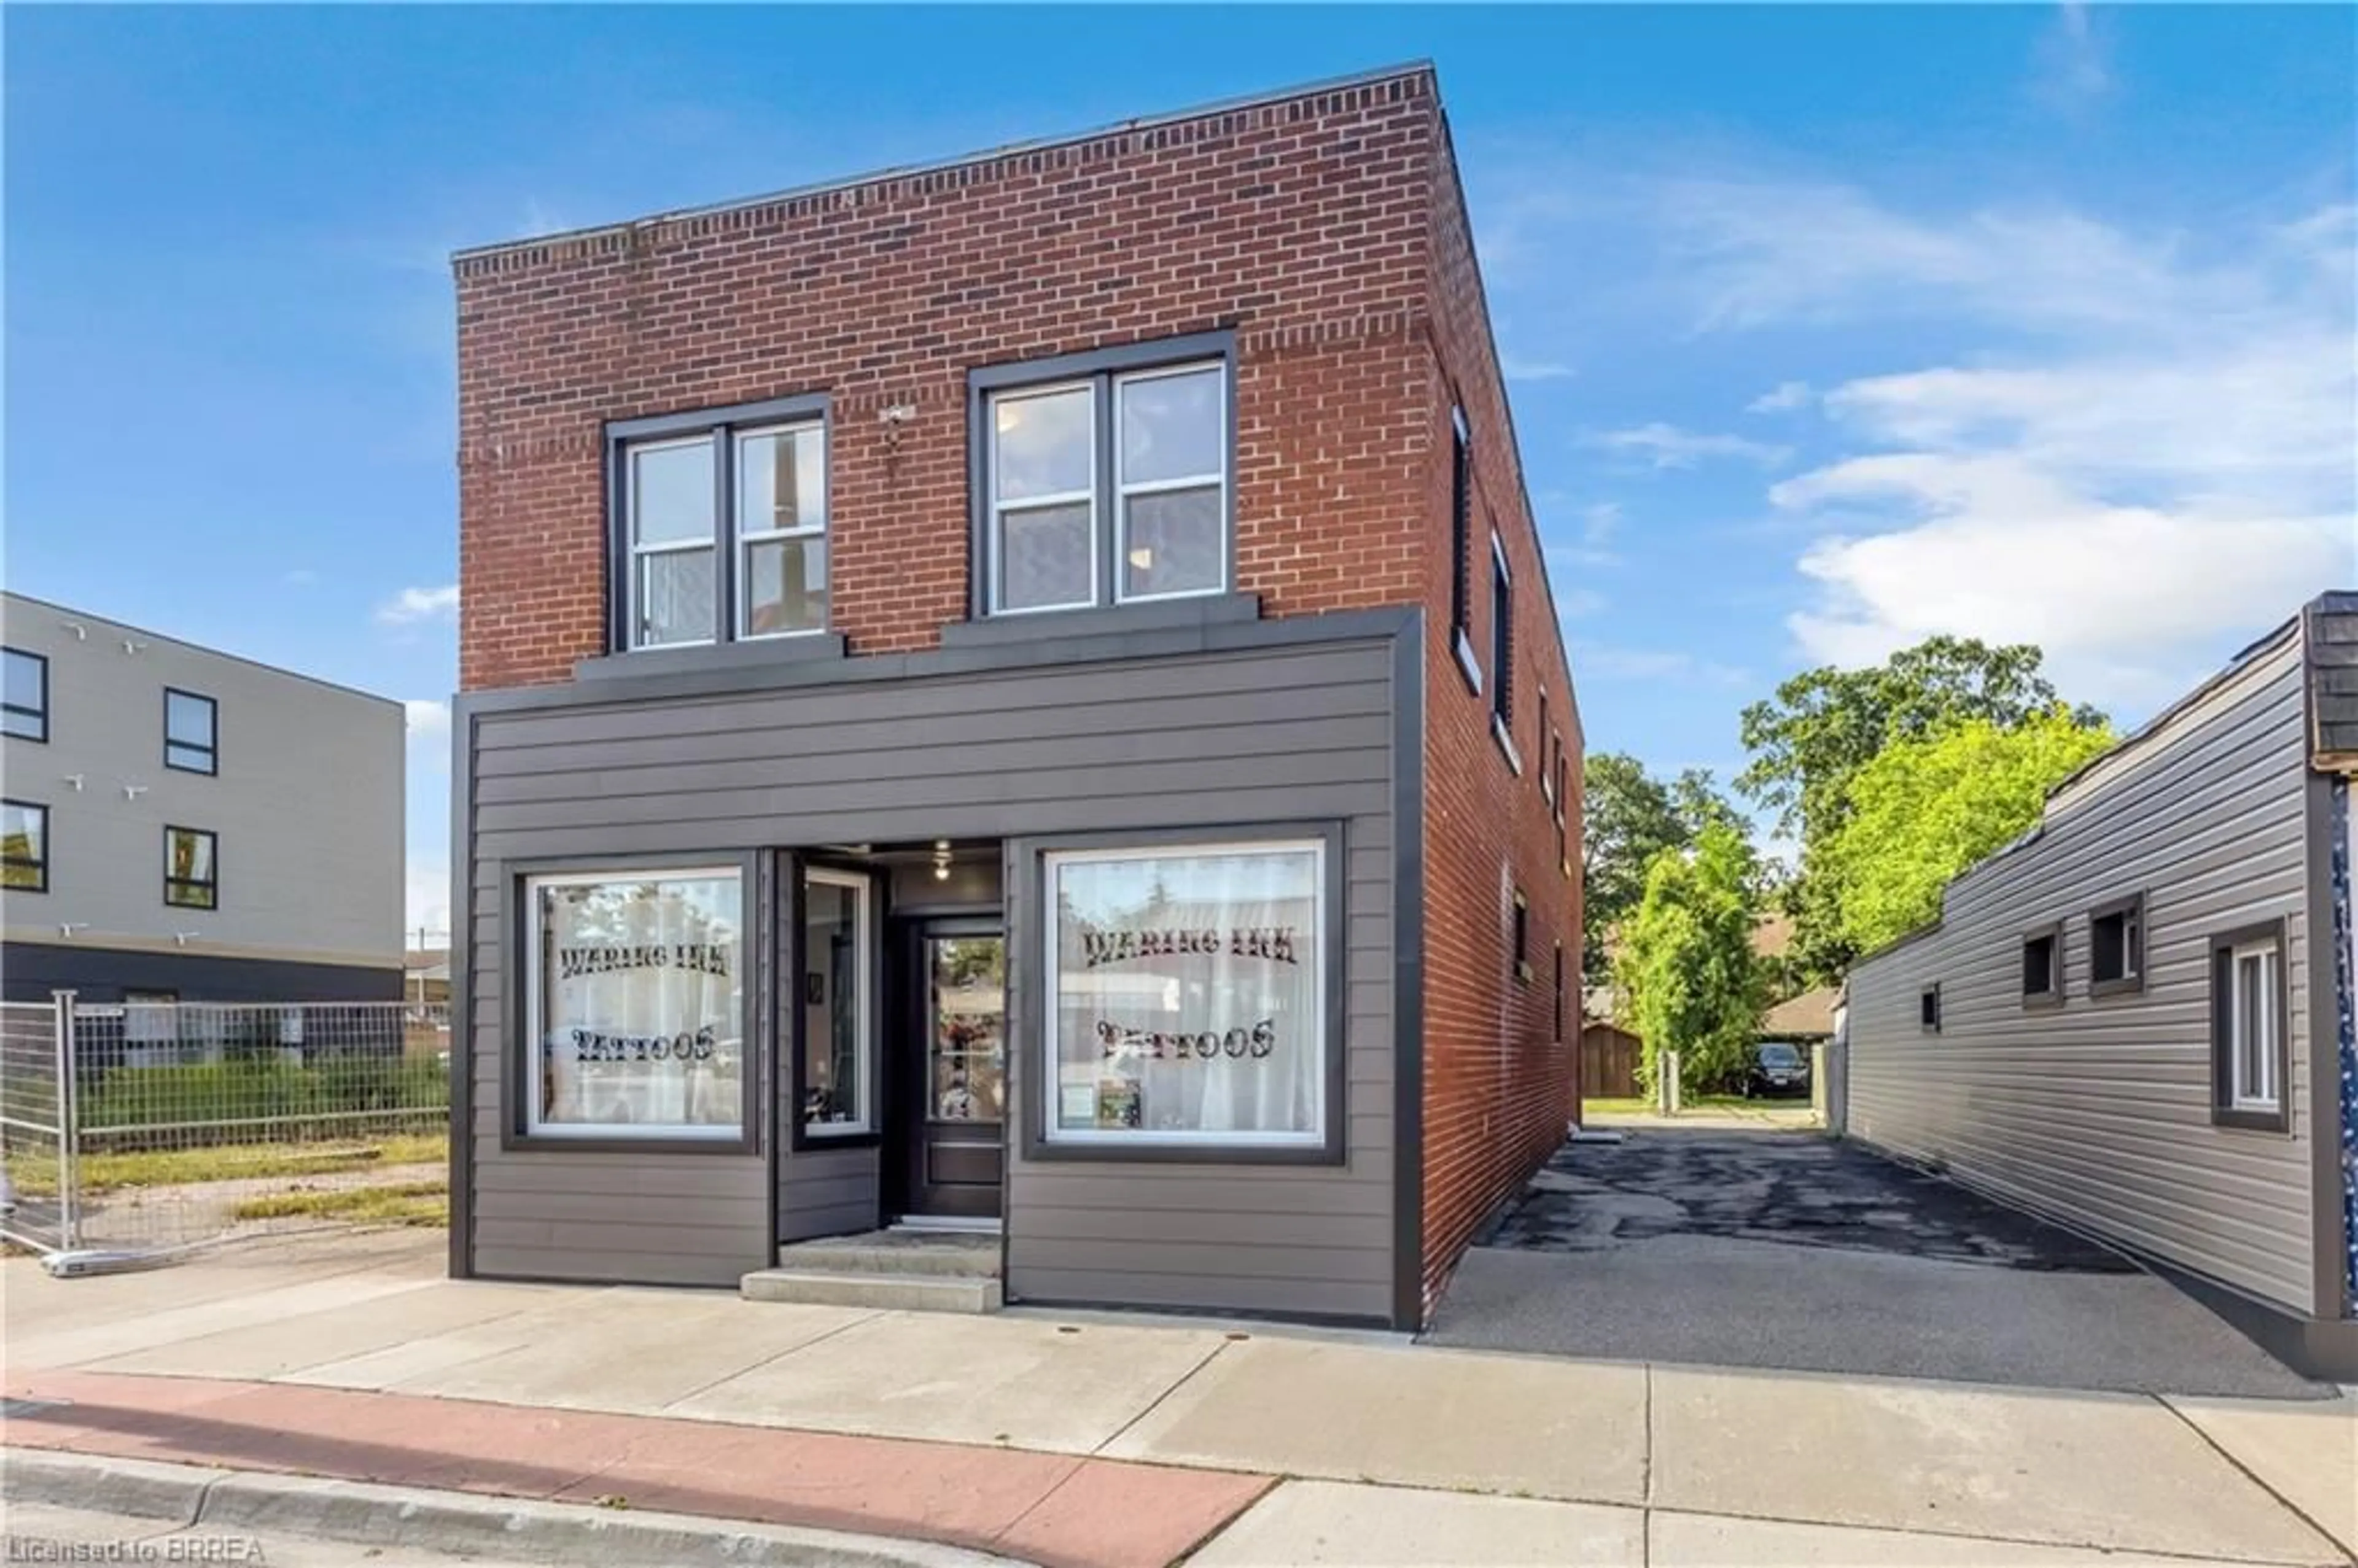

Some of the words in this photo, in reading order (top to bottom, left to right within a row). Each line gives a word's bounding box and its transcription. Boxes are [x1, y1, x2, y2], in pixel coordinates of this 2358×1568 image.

[559, 945, 667, 979] WARING
[676, 943, 728, 977] INK
[1083, 928, 1221, 968] WARING
[1231, 927, 1298, 965] INK
[572, 1024, 715, 1062] TATTOOS
